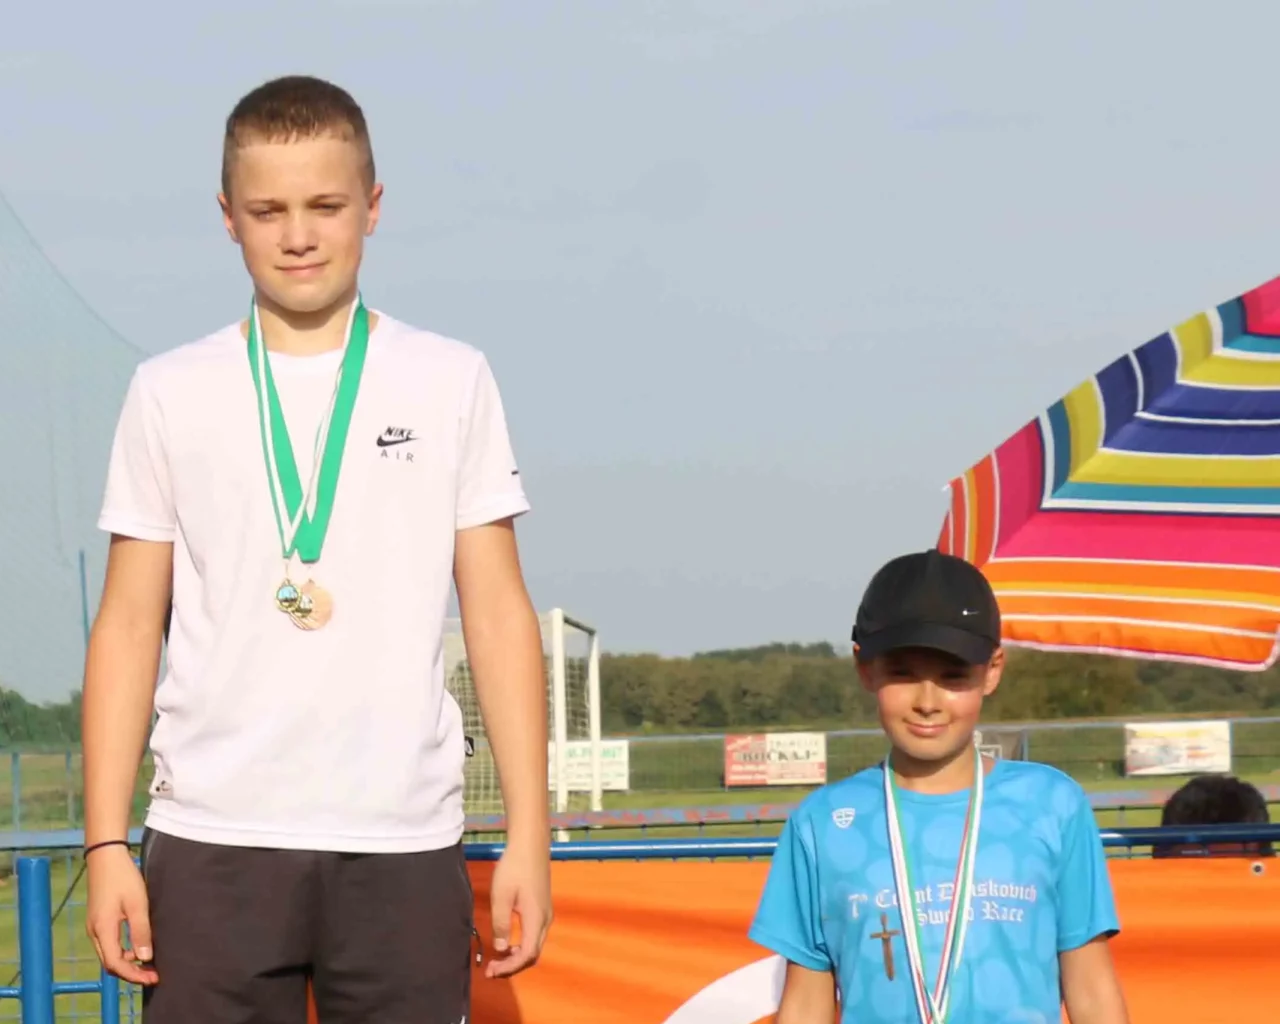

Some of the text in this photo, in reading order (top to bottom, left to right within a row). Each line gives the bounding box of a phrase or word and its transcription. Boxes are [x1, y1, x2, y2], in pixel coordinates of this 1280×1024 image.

[384, 426, 415, 440] NIKE
[380, 449, 414, 463] AIR
[876, 885, 933, 909] Cont
[937, 879, 1037, 903] Dskovich
[916, 900, 1024, 926] Swod Race
